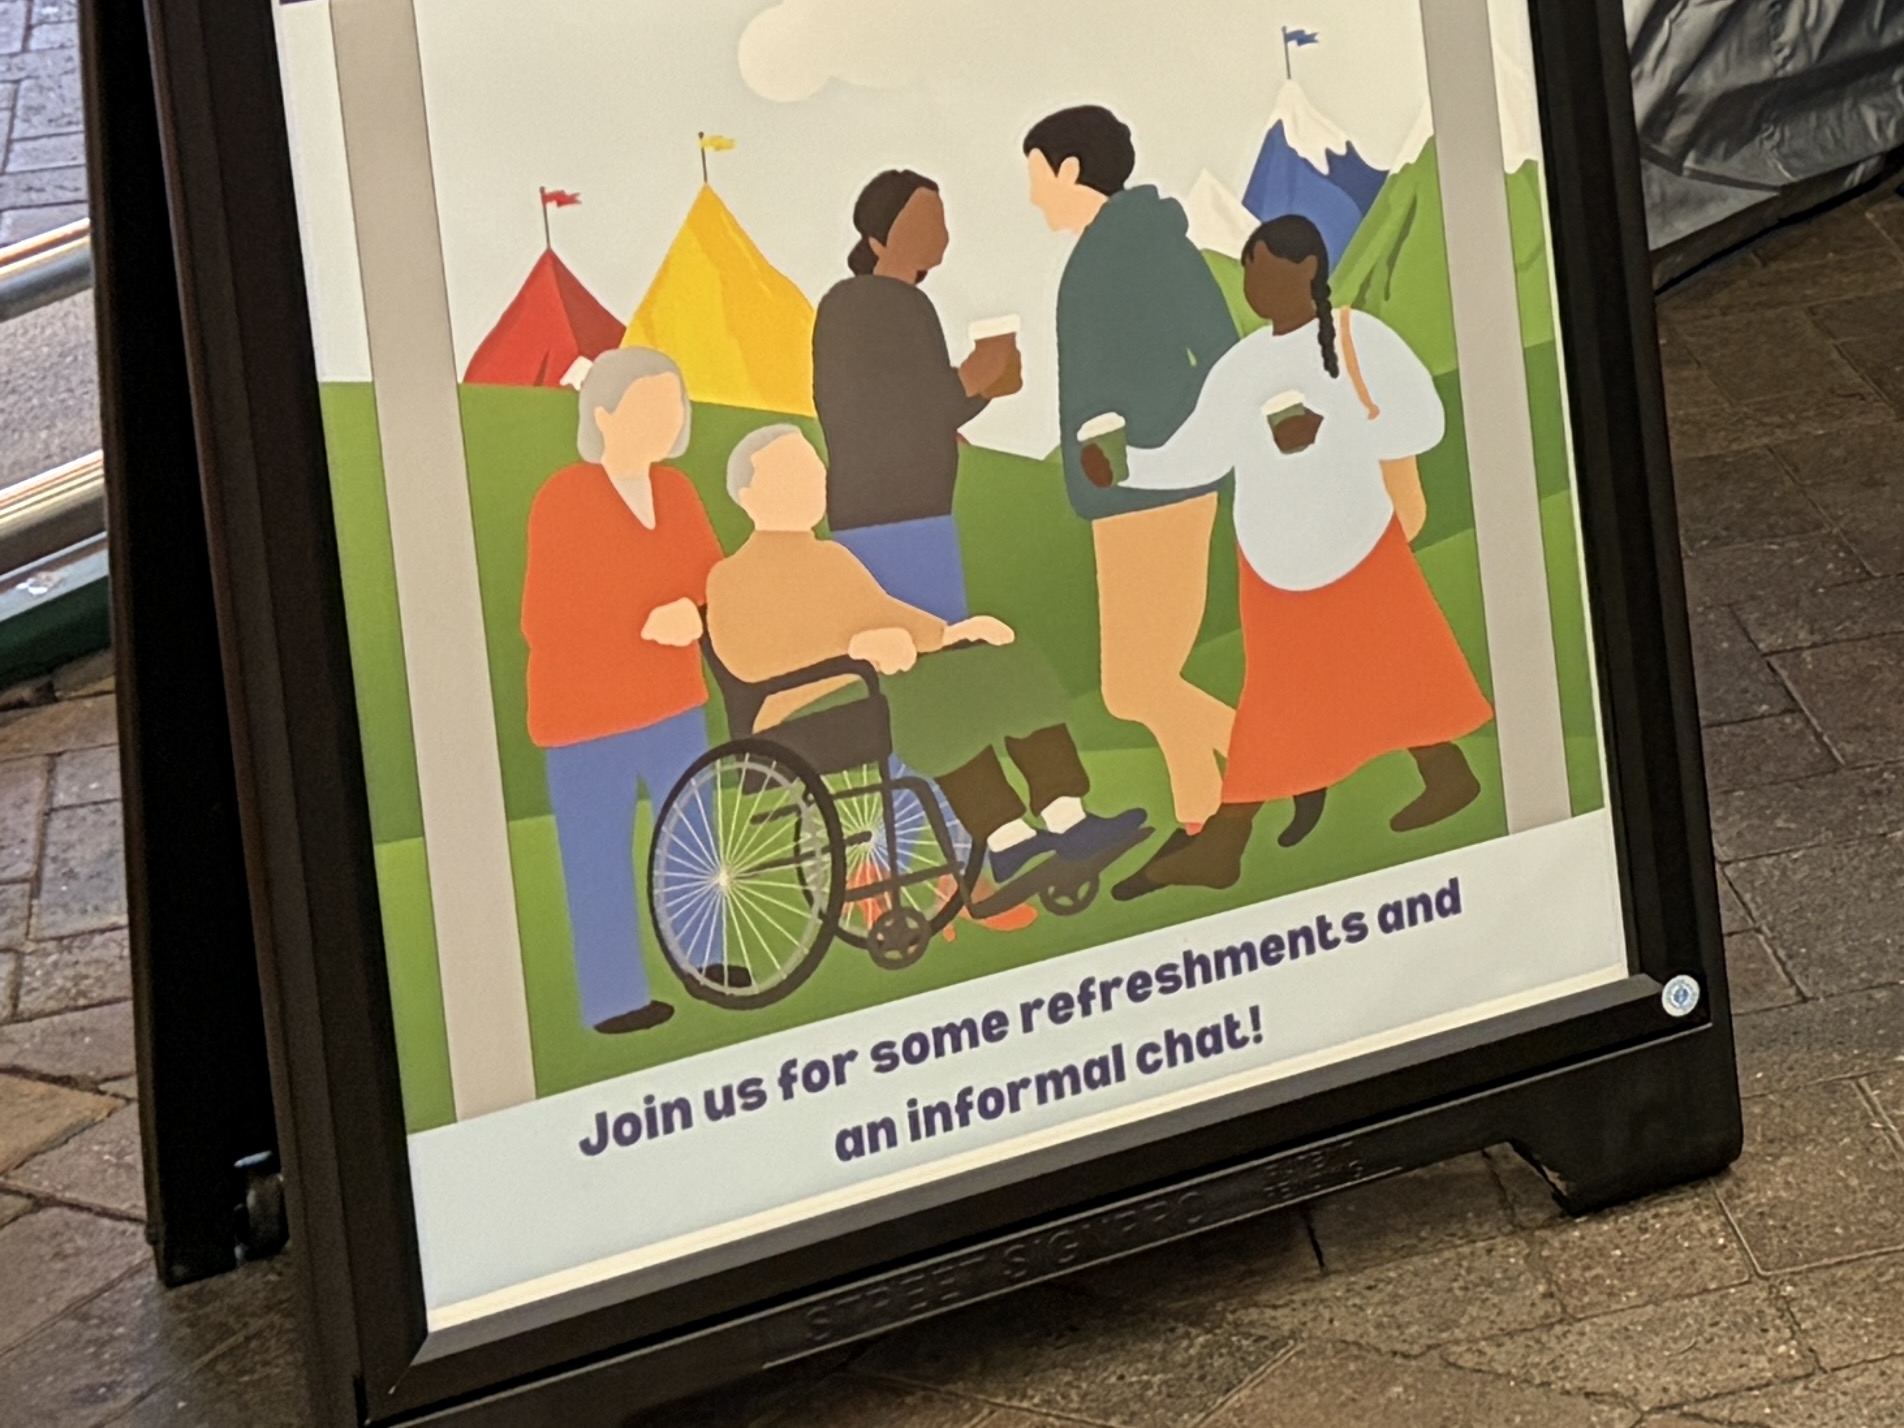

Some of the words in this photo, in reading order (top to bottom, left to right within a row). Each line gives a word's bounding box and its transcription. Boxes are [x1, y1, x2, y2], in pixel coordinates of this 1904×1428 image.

[578, 1094, 693, 1157] Join
[703, 1076, 768, 1122] us
[777, 1048, 859, 1101] for
[870, 1008, 1009, 1074] some
[1019, 911, 1370, 1034] refreshments
[1377, 877, 1462, 935] and
[834, 1116, 899, 1162] an
[907, 1043, 1127, 1142] informal
[1136, 1004, 1264, 1075] chat!
